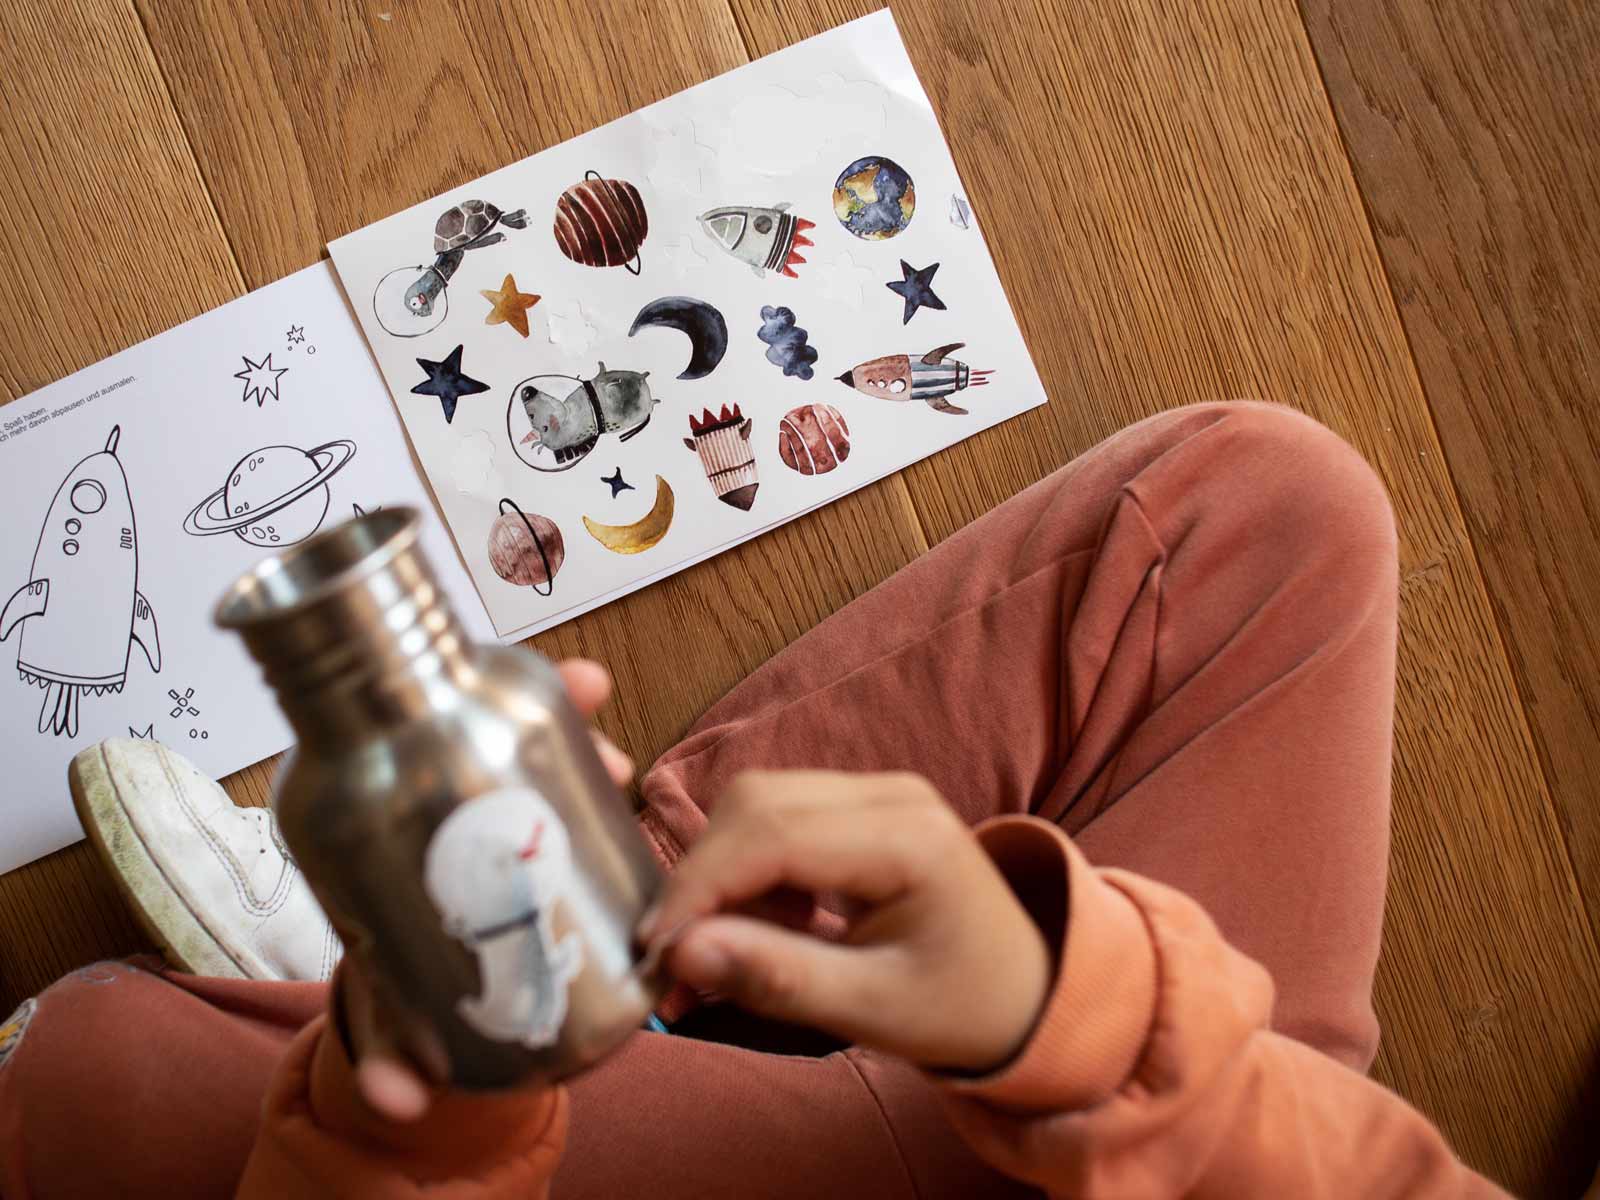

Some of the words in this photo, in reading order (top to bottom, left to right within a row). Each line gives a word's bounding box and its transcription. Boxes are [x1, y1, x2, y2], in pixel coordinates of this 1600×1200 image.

[4, 416, 23, 430] Spaß
[10, 425, 27, 438] mehr
[29, 415, 50, 428] davon
[51, 398, 85, 418] abpausen
[86, 391, 100, 402] und
